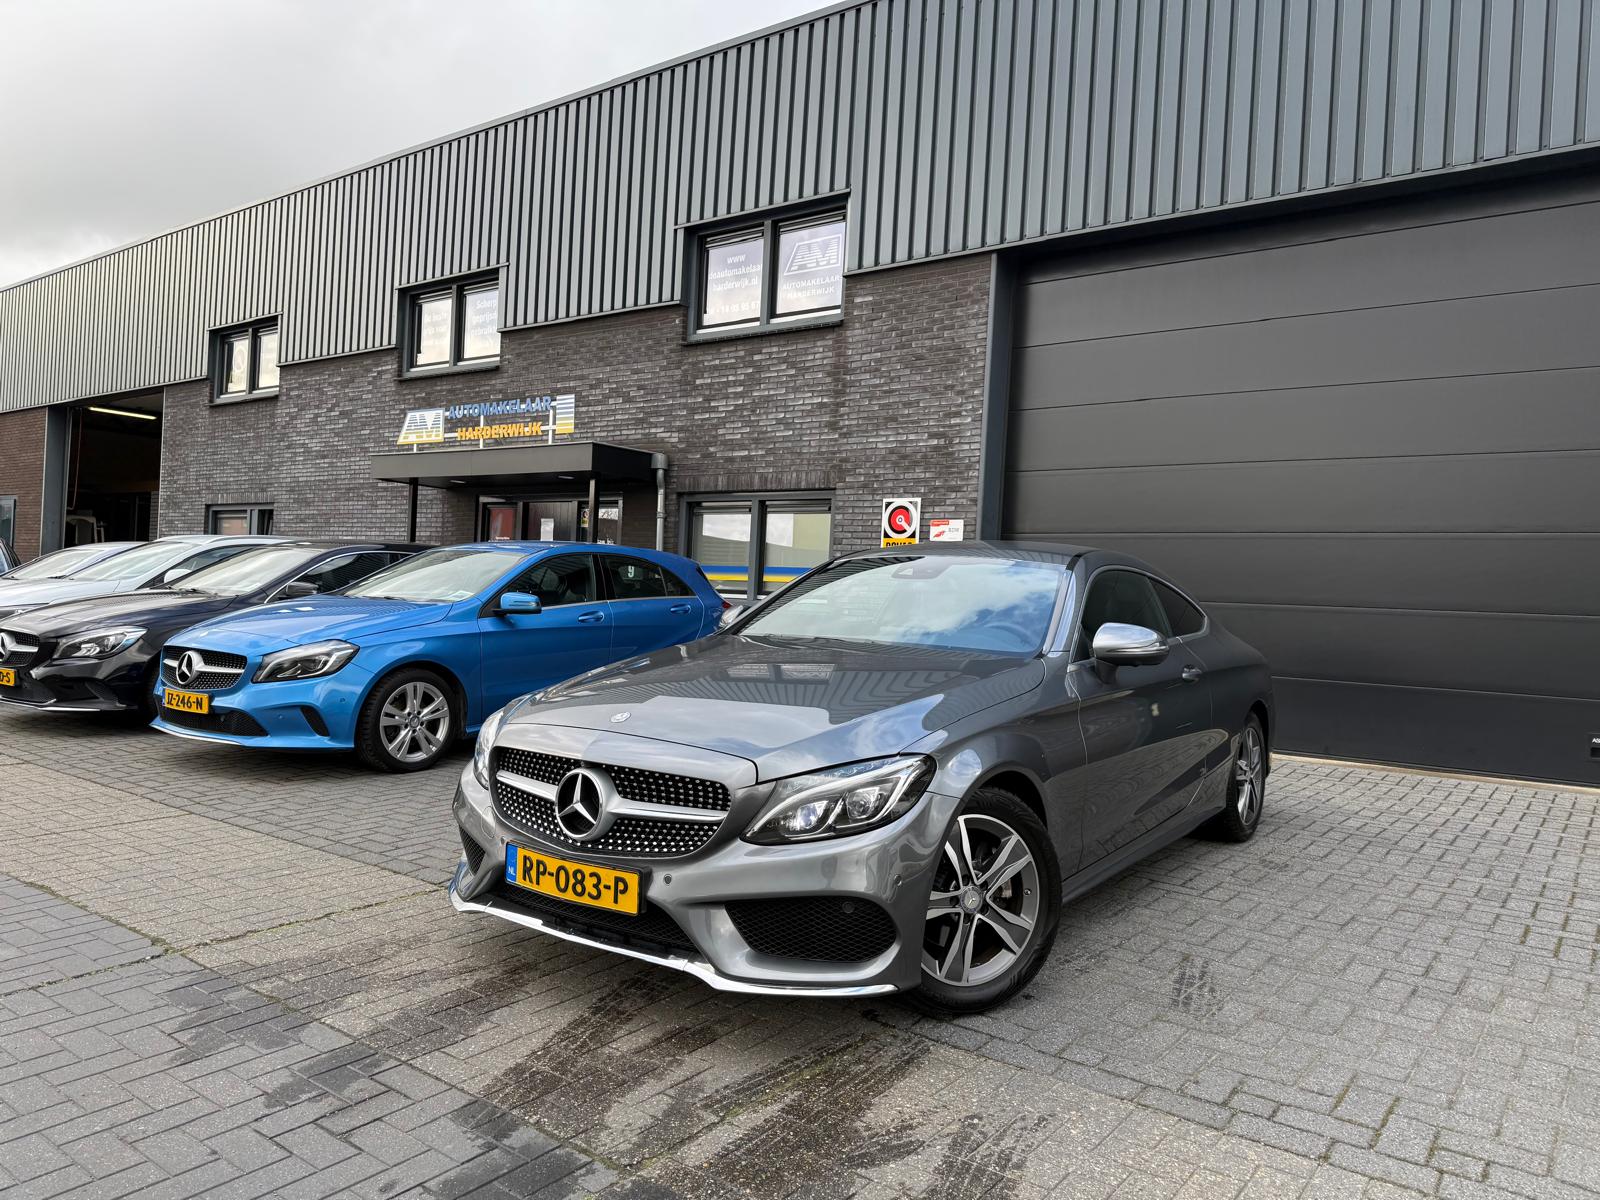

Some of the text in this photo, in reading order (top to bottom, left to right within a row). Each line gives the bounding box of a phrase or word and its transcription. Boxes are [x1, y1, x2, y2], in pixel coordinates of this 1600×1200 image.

[448, 396, 551, 420] AUTOMAKELAAR
[457, 421, 543, 441] HARDERWIJK
[507, 866, 515, 876] NL
[522, 855, 629, 905] RP-083-P
